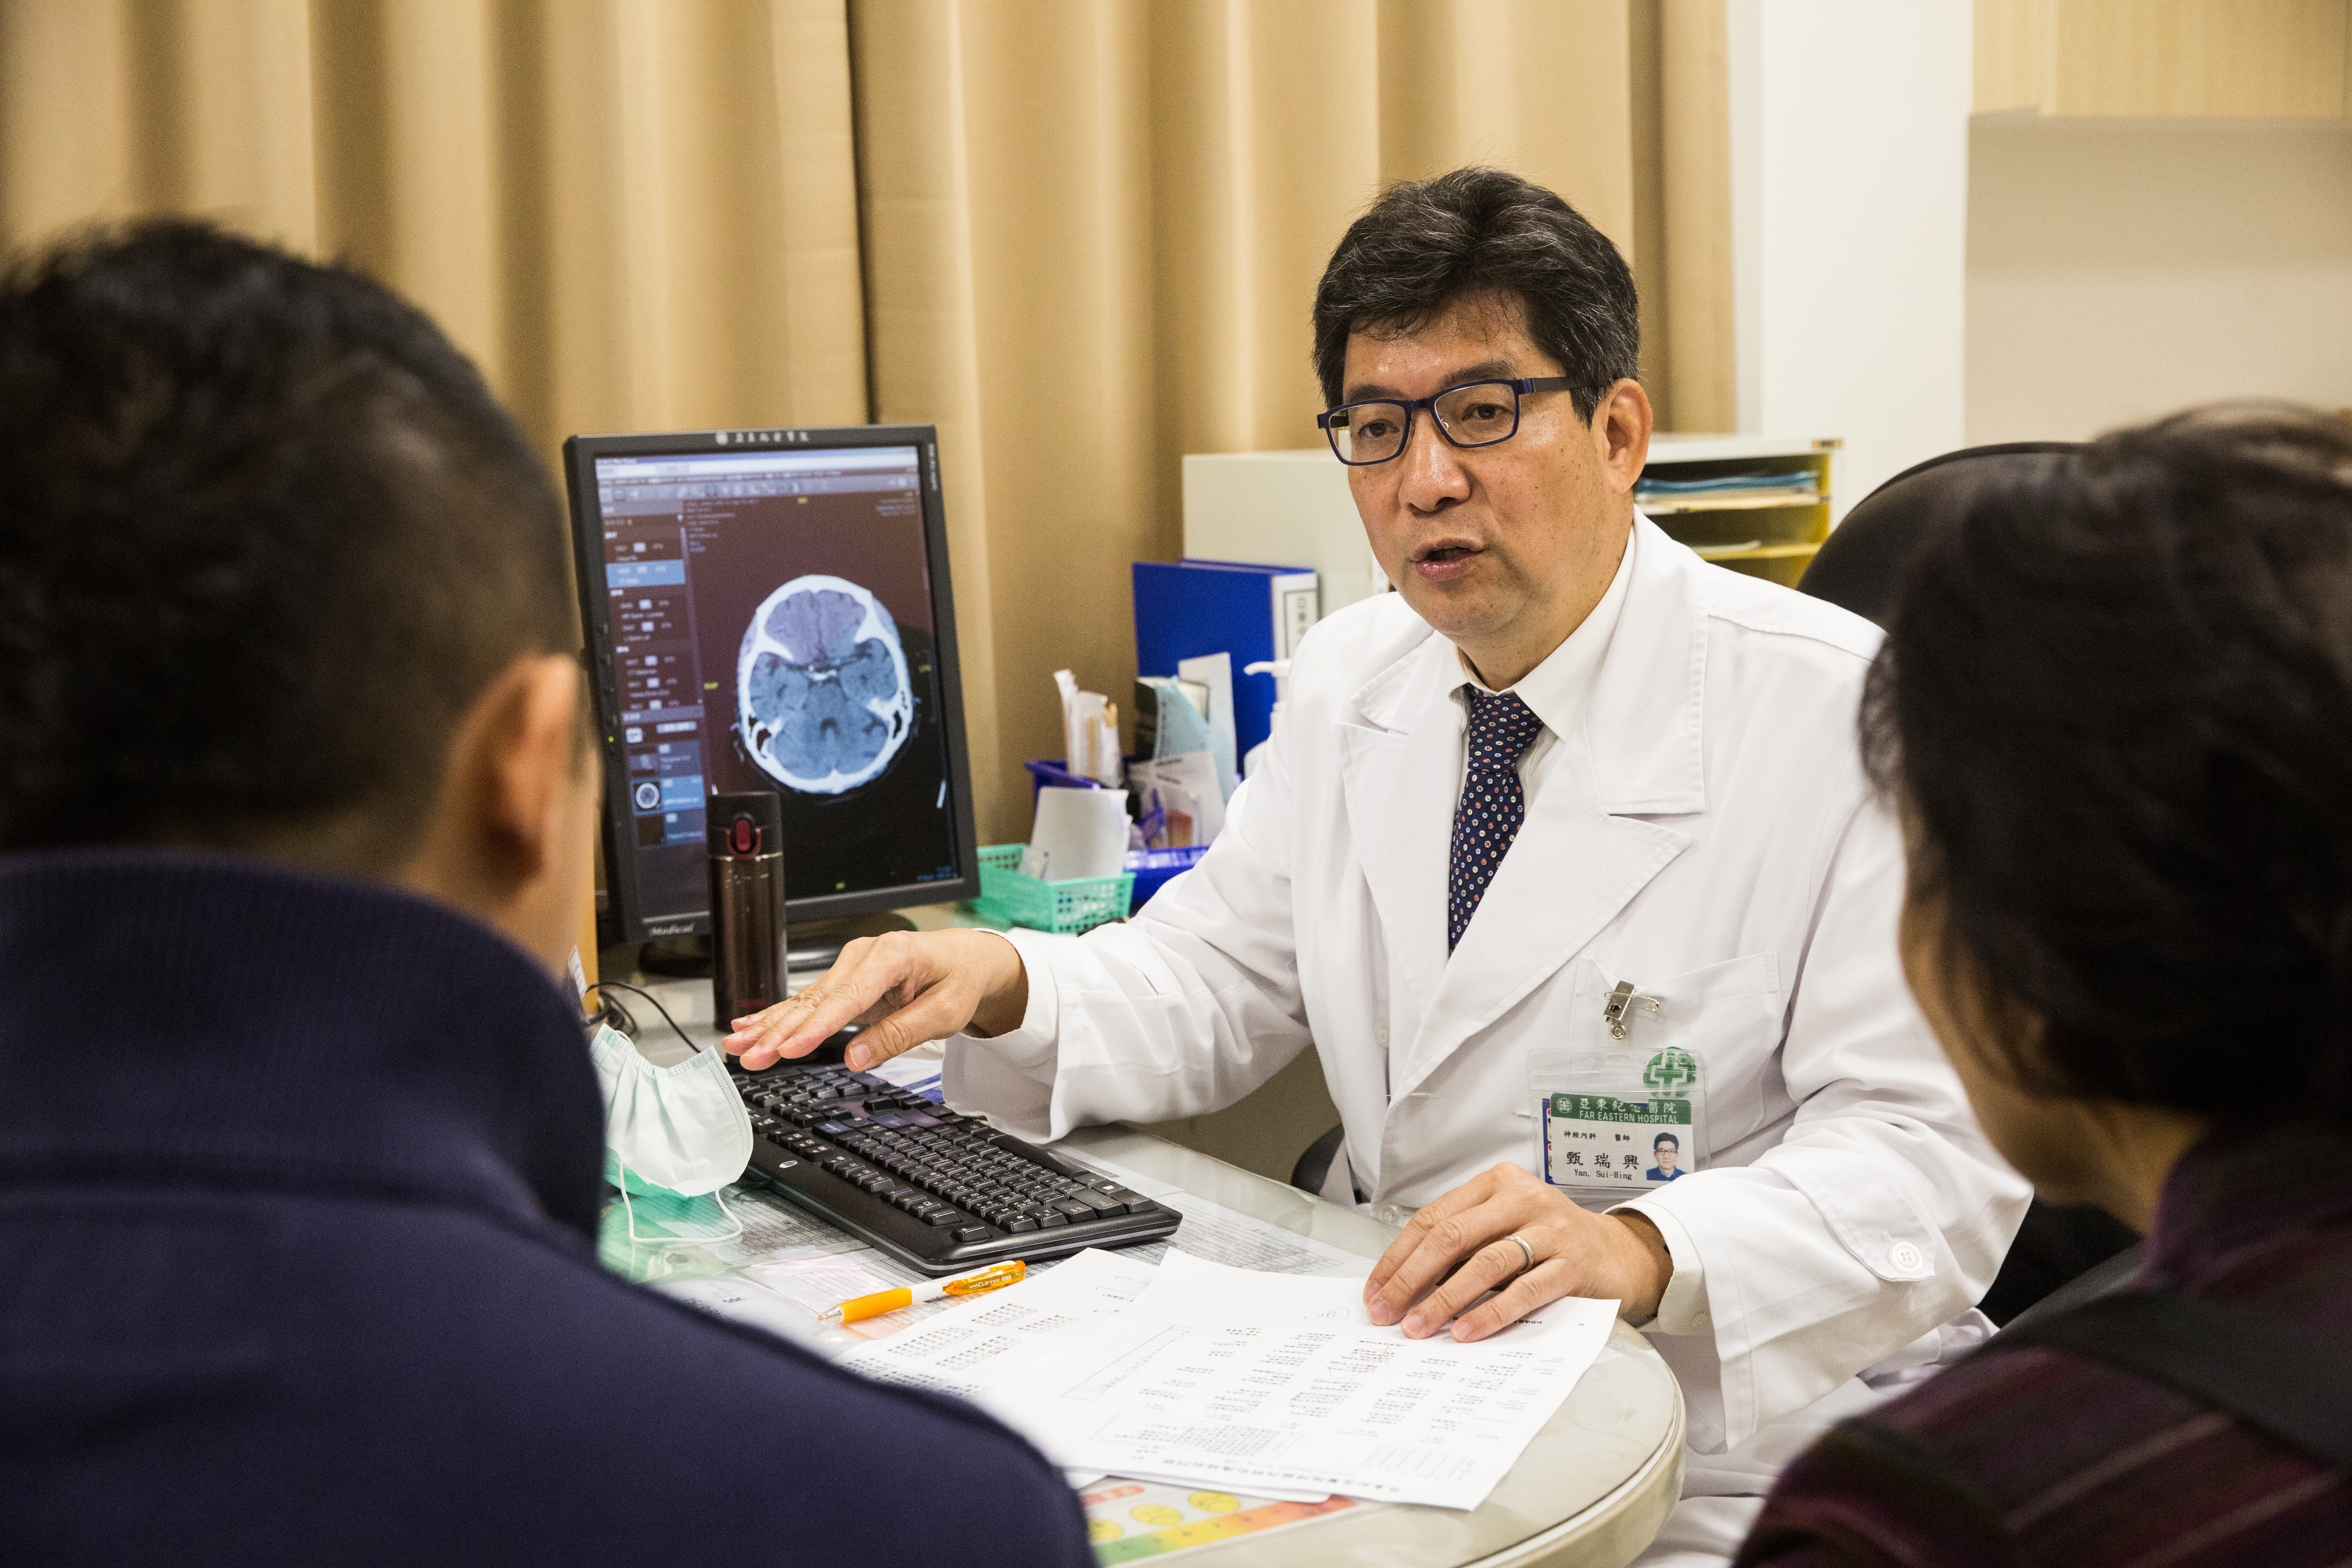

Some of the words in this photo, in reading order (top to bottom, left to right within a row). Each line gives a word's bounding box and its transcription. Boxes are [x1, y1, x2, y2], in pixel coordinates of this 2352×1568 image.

[1579, 1110, 1595, 1120] FAR
[1597, 1111, 1635, 1123] EASTERN
[1637, 1114, 1679, 1124] HOSPITAL
[1564, 1130, 1597, 1140] 神經內科
[1615, 1134, 1630, 1142] 醫師
[1574, 1169, 1590, 1178] Yan,
[1596, 1170, 1632, 1180] Sui-Hing
